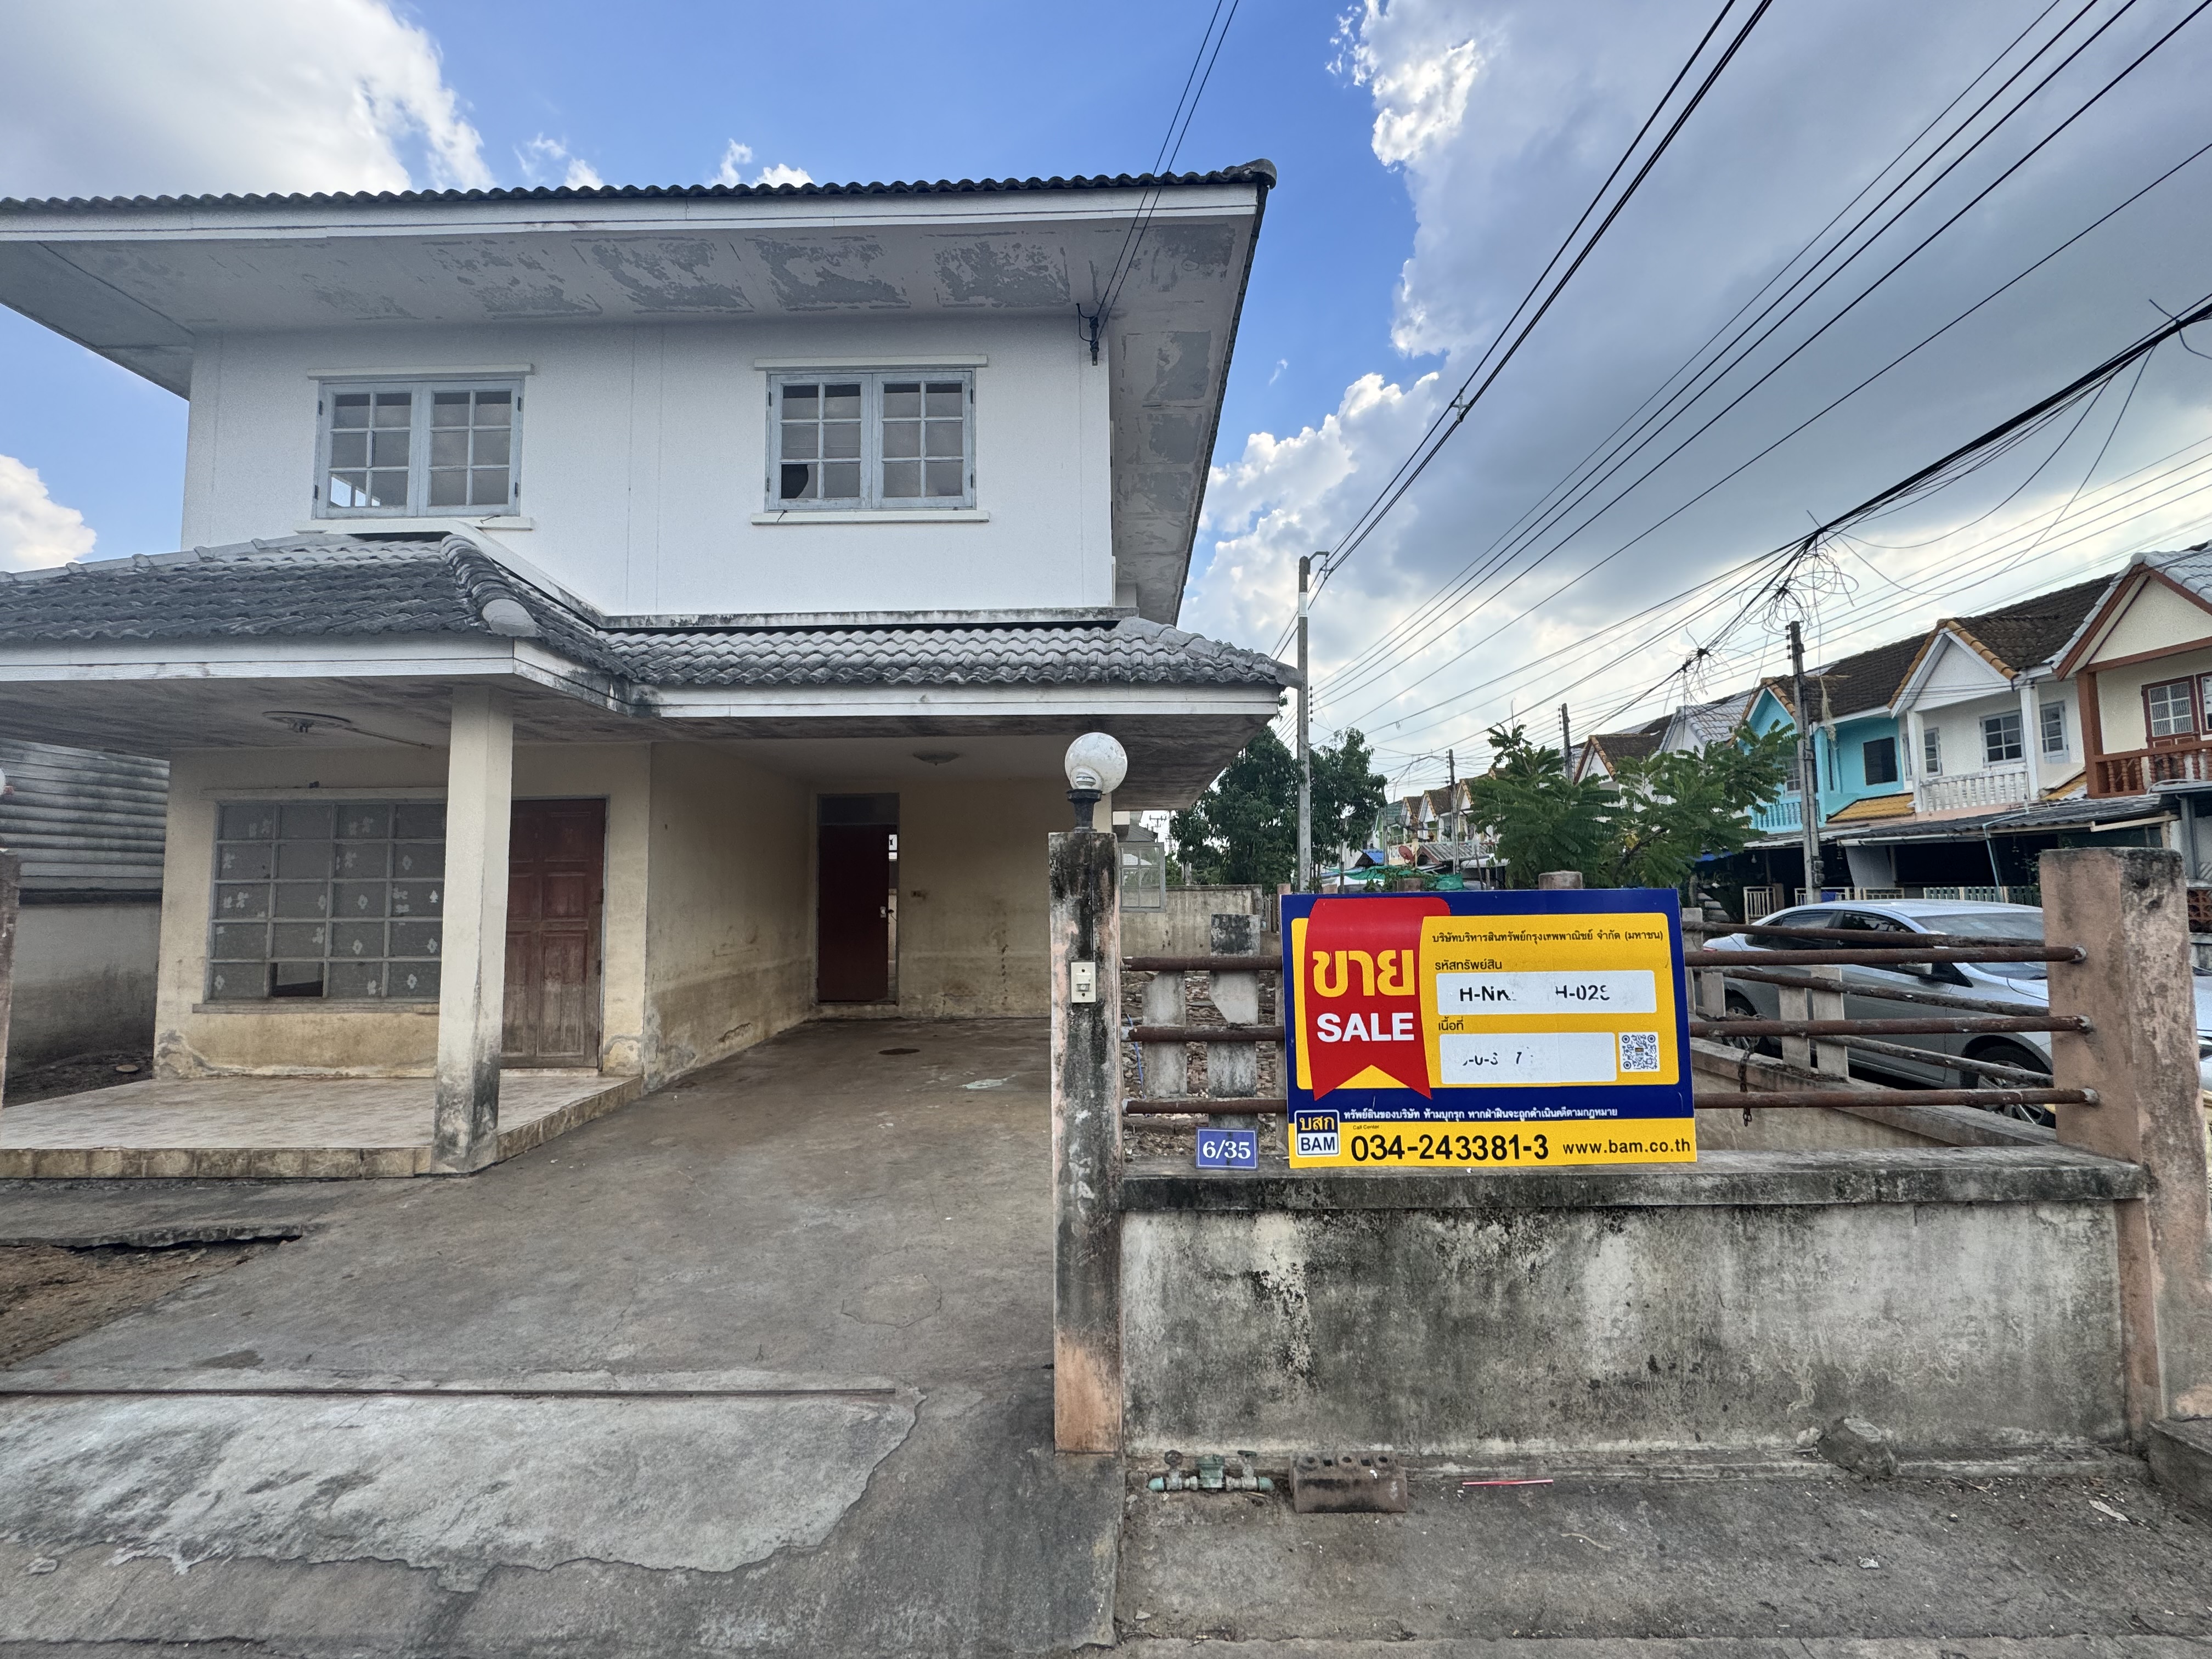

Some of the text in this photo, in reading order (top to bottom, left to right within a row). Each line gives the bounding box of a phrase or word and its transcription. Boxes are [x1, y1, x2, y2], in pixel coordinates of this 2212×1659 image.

[1597, 929, 1621, 940] จำกัด
[1624, 930, 1663, 941] (มหาชน)
[1435, 958, 1502, 970] รหัสทรัพย์สิน
[1313, 950, 1415, 998] ขาย
[1317, 1012, 1414, 1042] SALE
[1438, 1016, 1464, 1031] เนื้อที่
[1300, 1116, 1335, 1131] บสก
[1203, 1139, 1251, 1159] 6/35
[1301, 1137, 1335, 1151] BAM
[1351, 1134, 1691, 1161] 034-243381-3 www.bam.co.th
